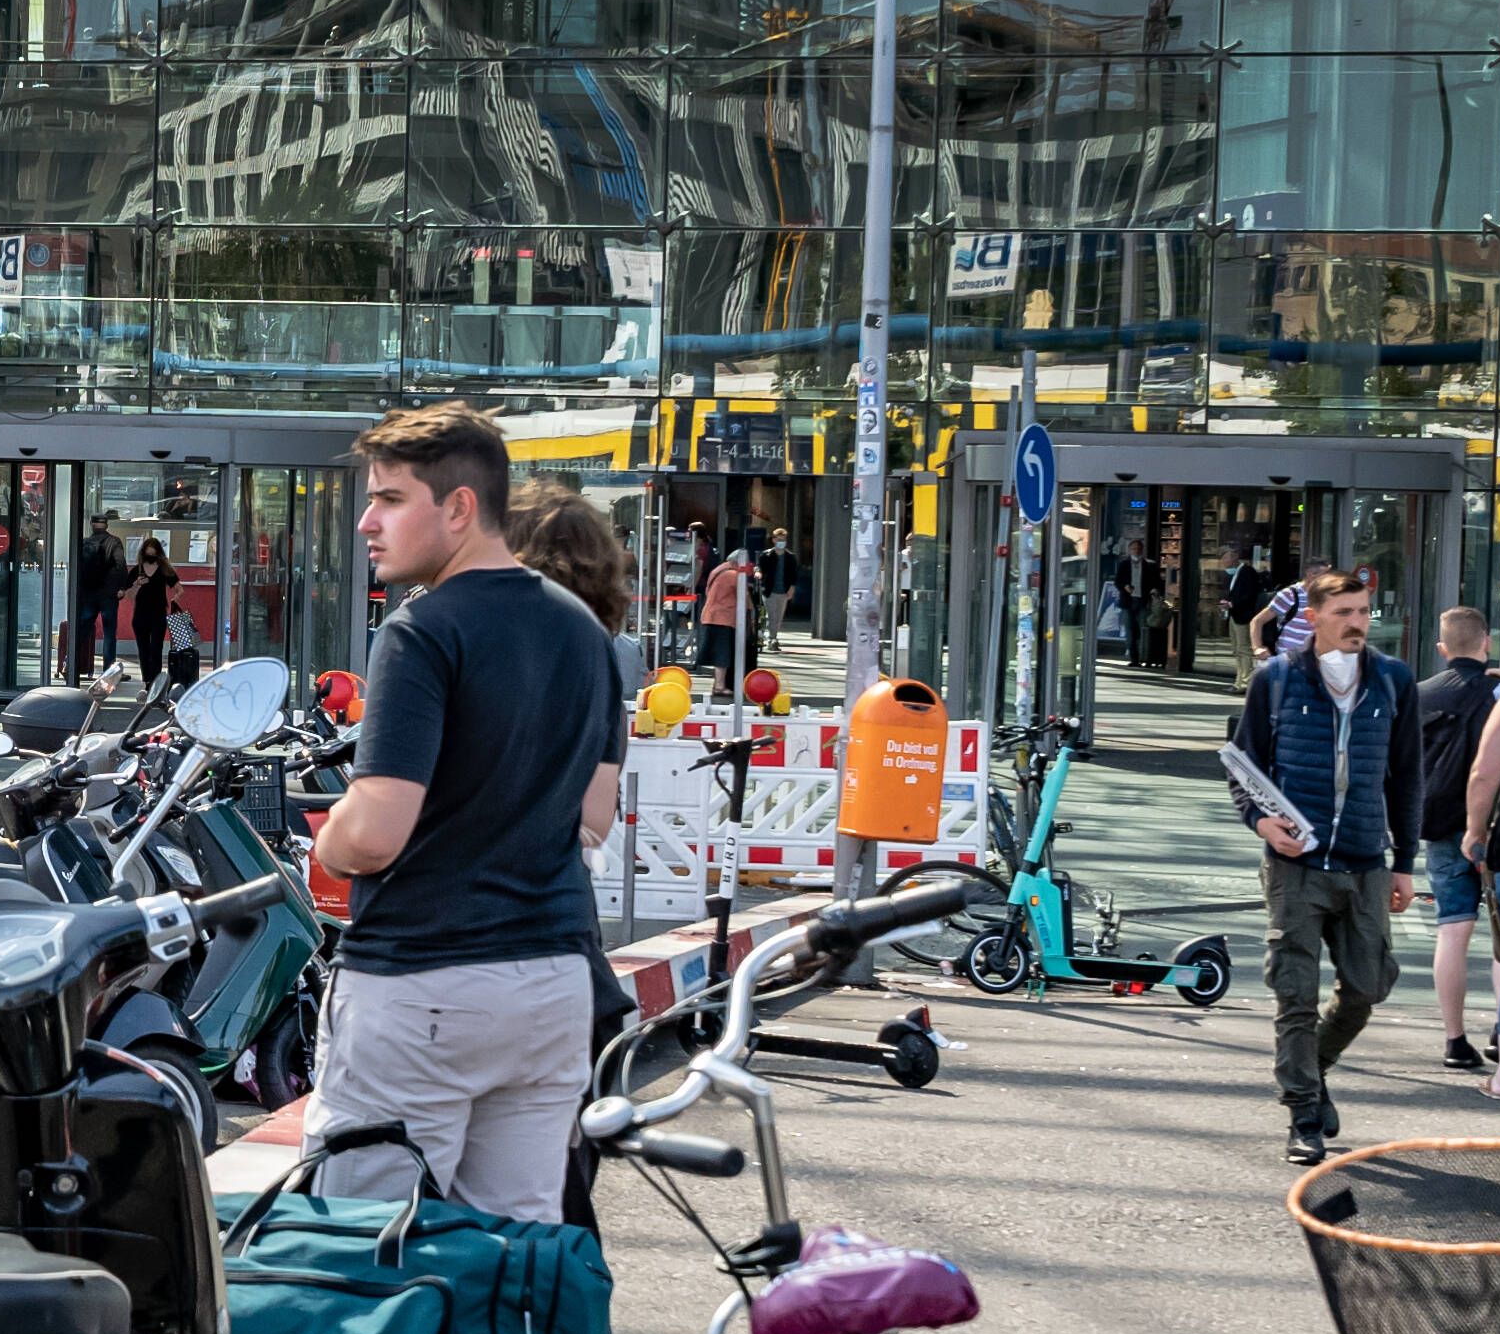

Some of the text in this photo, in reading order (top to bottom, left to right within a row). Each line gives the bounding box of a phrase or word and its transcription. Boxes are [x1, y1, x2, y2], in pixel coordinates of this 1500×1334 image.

[716, 444, 738, 458] 1-4
[883, 755, 893, 766] in
[722, 837, 735, 883] BIRD
